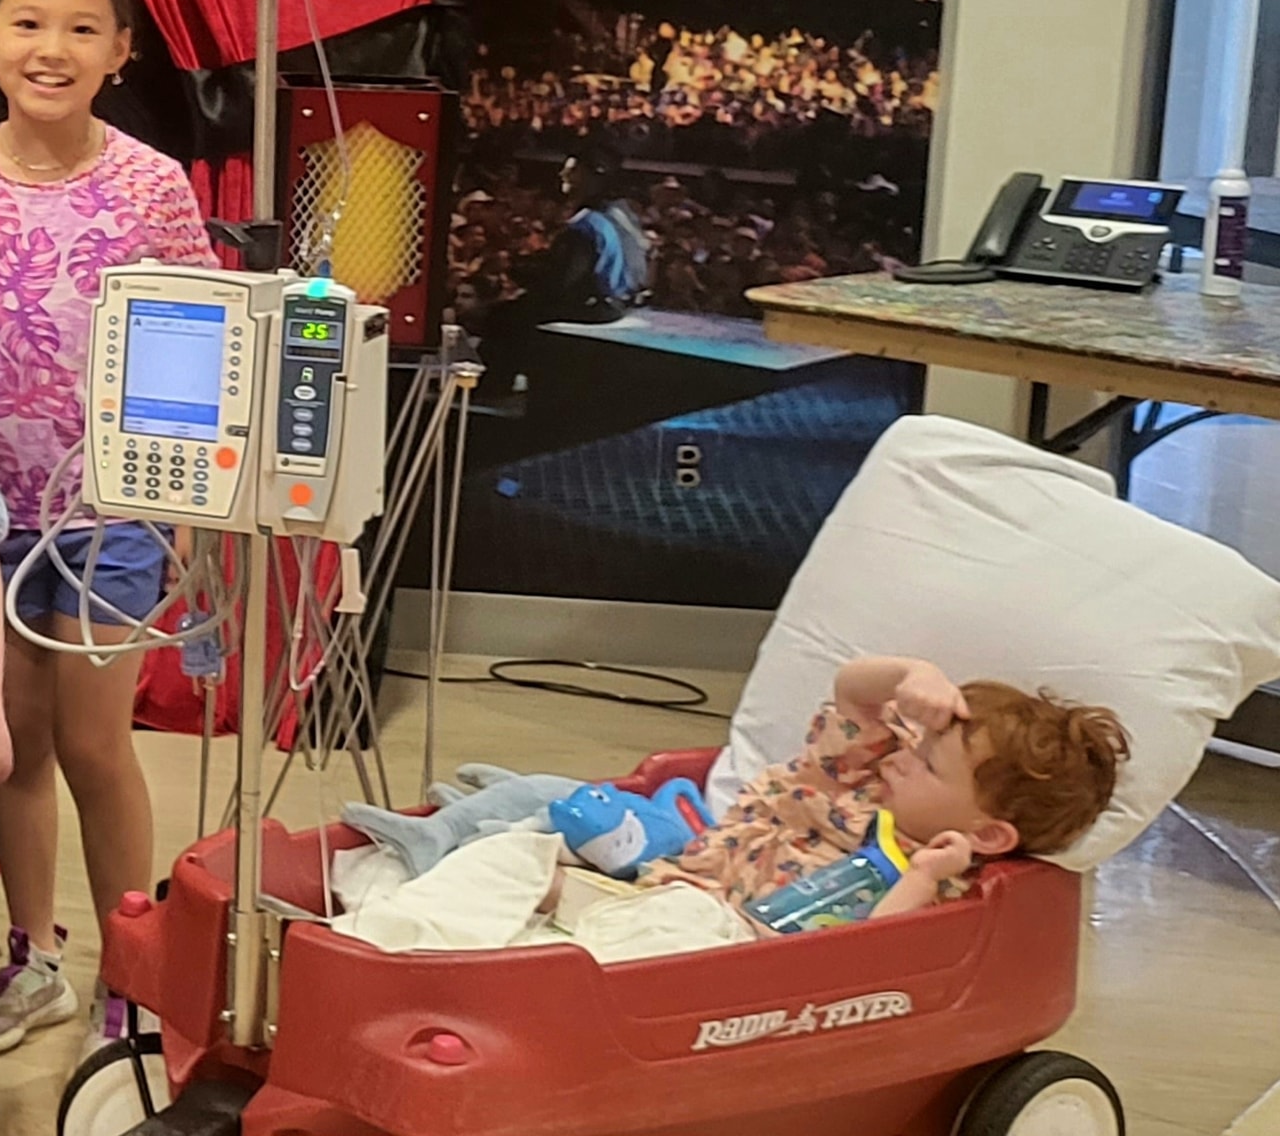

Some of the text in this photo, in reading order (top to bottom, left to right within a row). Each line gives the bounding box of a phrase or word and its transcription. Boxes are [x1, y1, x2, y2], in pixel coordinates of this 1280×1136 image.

[301, 322, 329, 341] 25
[691, 991, 912, 1051] RADIO FLYER
